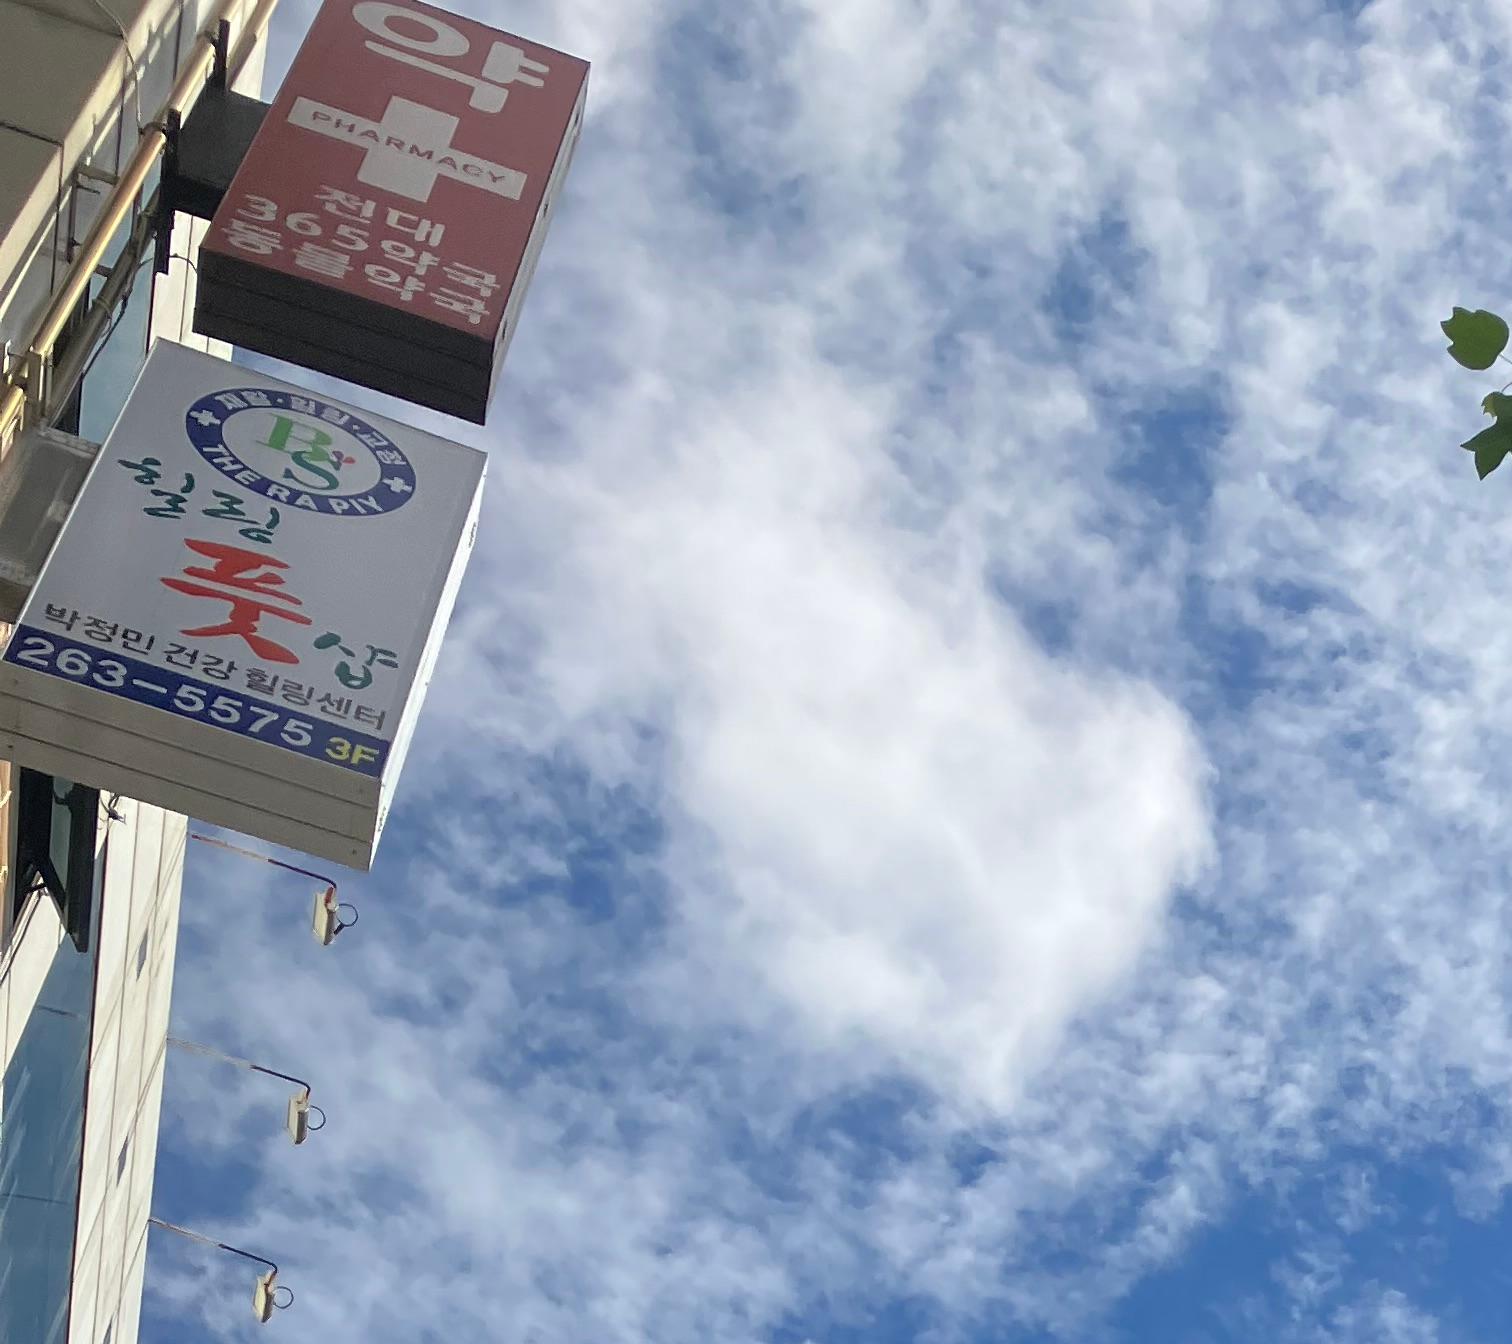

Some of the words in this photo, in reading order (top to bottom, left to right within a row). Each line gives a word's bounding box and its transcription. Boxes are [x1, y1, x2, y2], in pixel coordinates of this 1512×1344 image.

[352, 1, 550, 114] 약
[311, 110, 506, 184] PHARMACY
[236, 193, 500, 297] 365약국
[314, 184, 446, 248] 전대
[117, 456, 280, 544] 힐링
[16, 636, 313, 747] 263-5575
[325, 736, 381, 766] 3F
[45, 602, 156, 654] 박정민
[163, 641, 239, 682] 건강
[245, 666, 388, 731] 힐링센터
